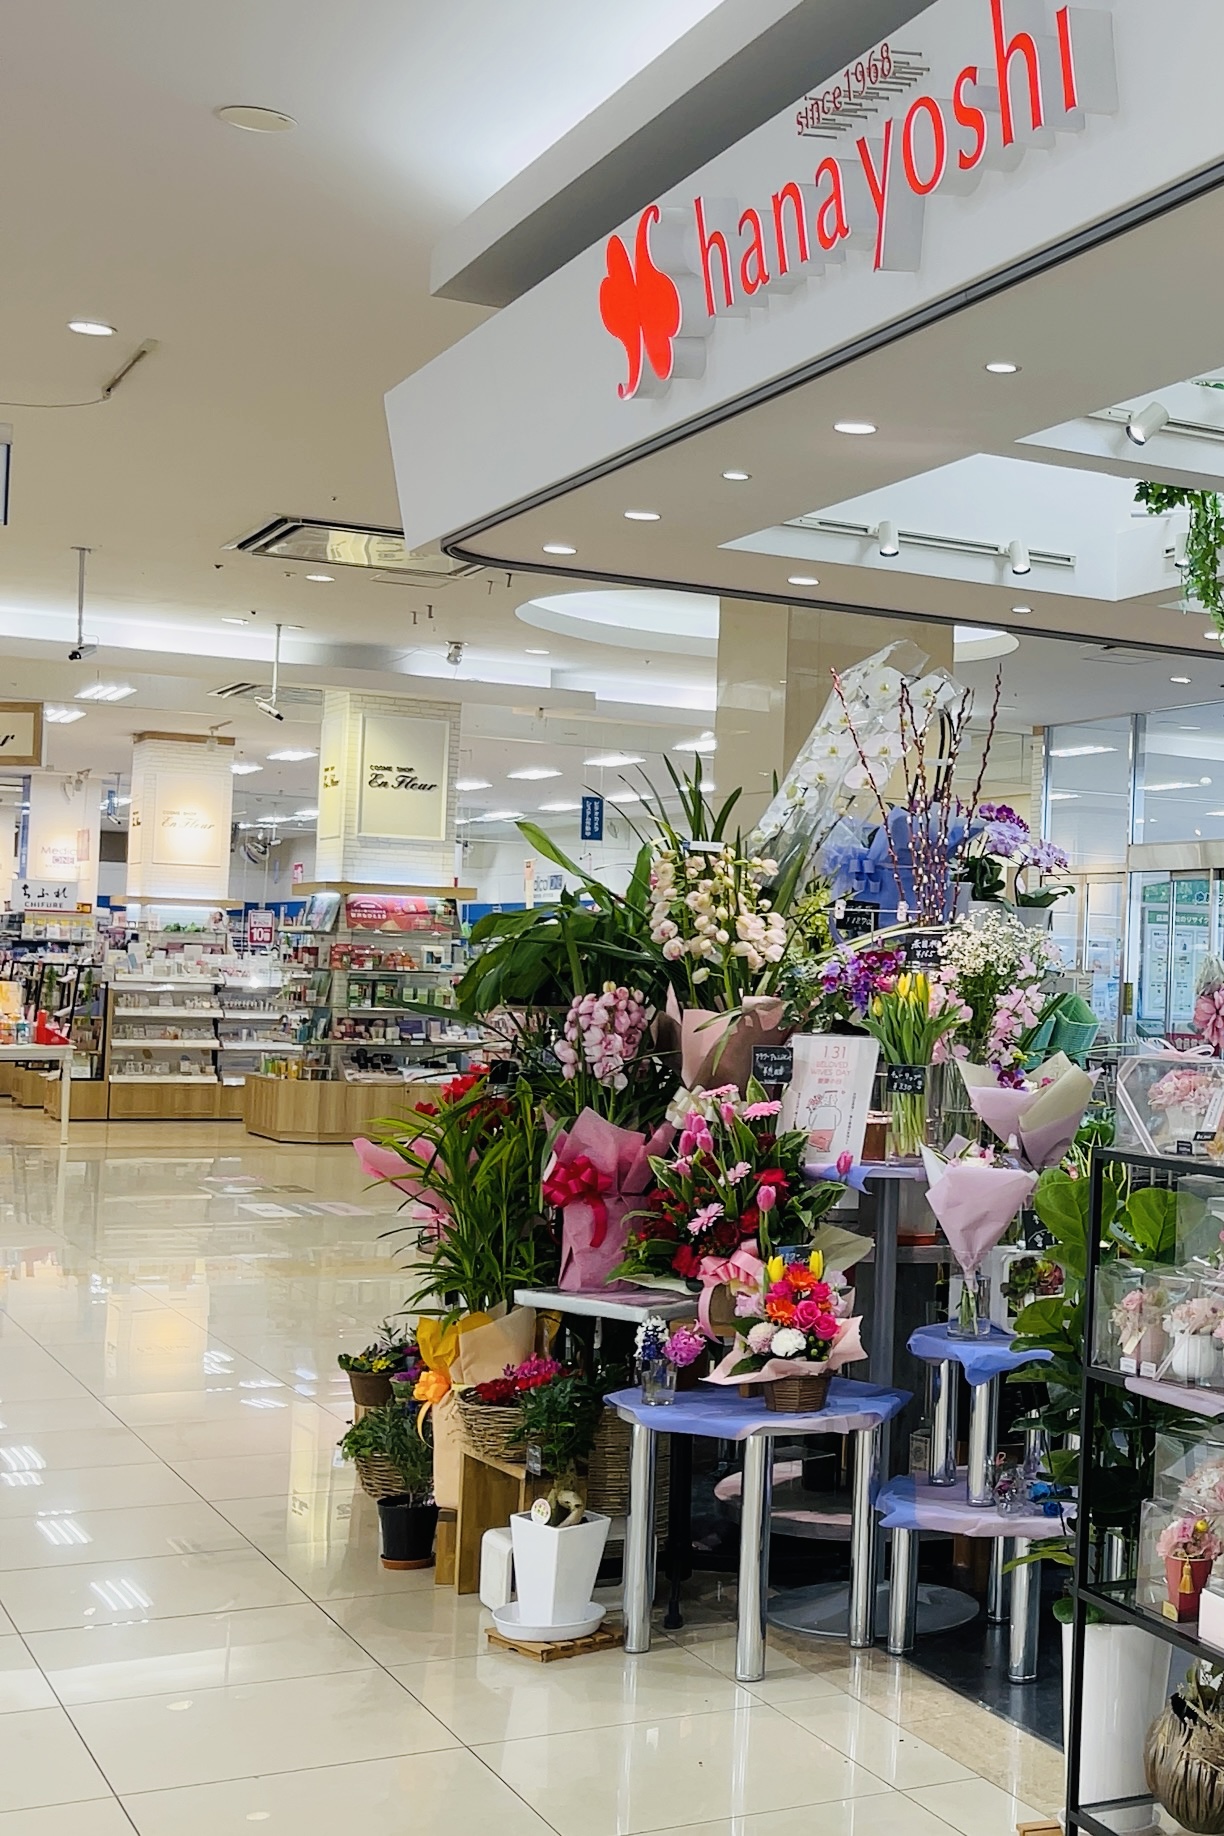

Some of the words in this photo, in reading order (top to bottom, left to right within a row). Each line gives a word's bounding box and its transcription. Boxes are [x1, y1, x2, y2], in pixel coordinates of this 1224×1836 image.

[368, 772, 389, 788] En
[391, 774, 437, 791] Fleur
[21, 883, 68, 900] ちふれ
[24, 901, 64, 909] CHIFURE
